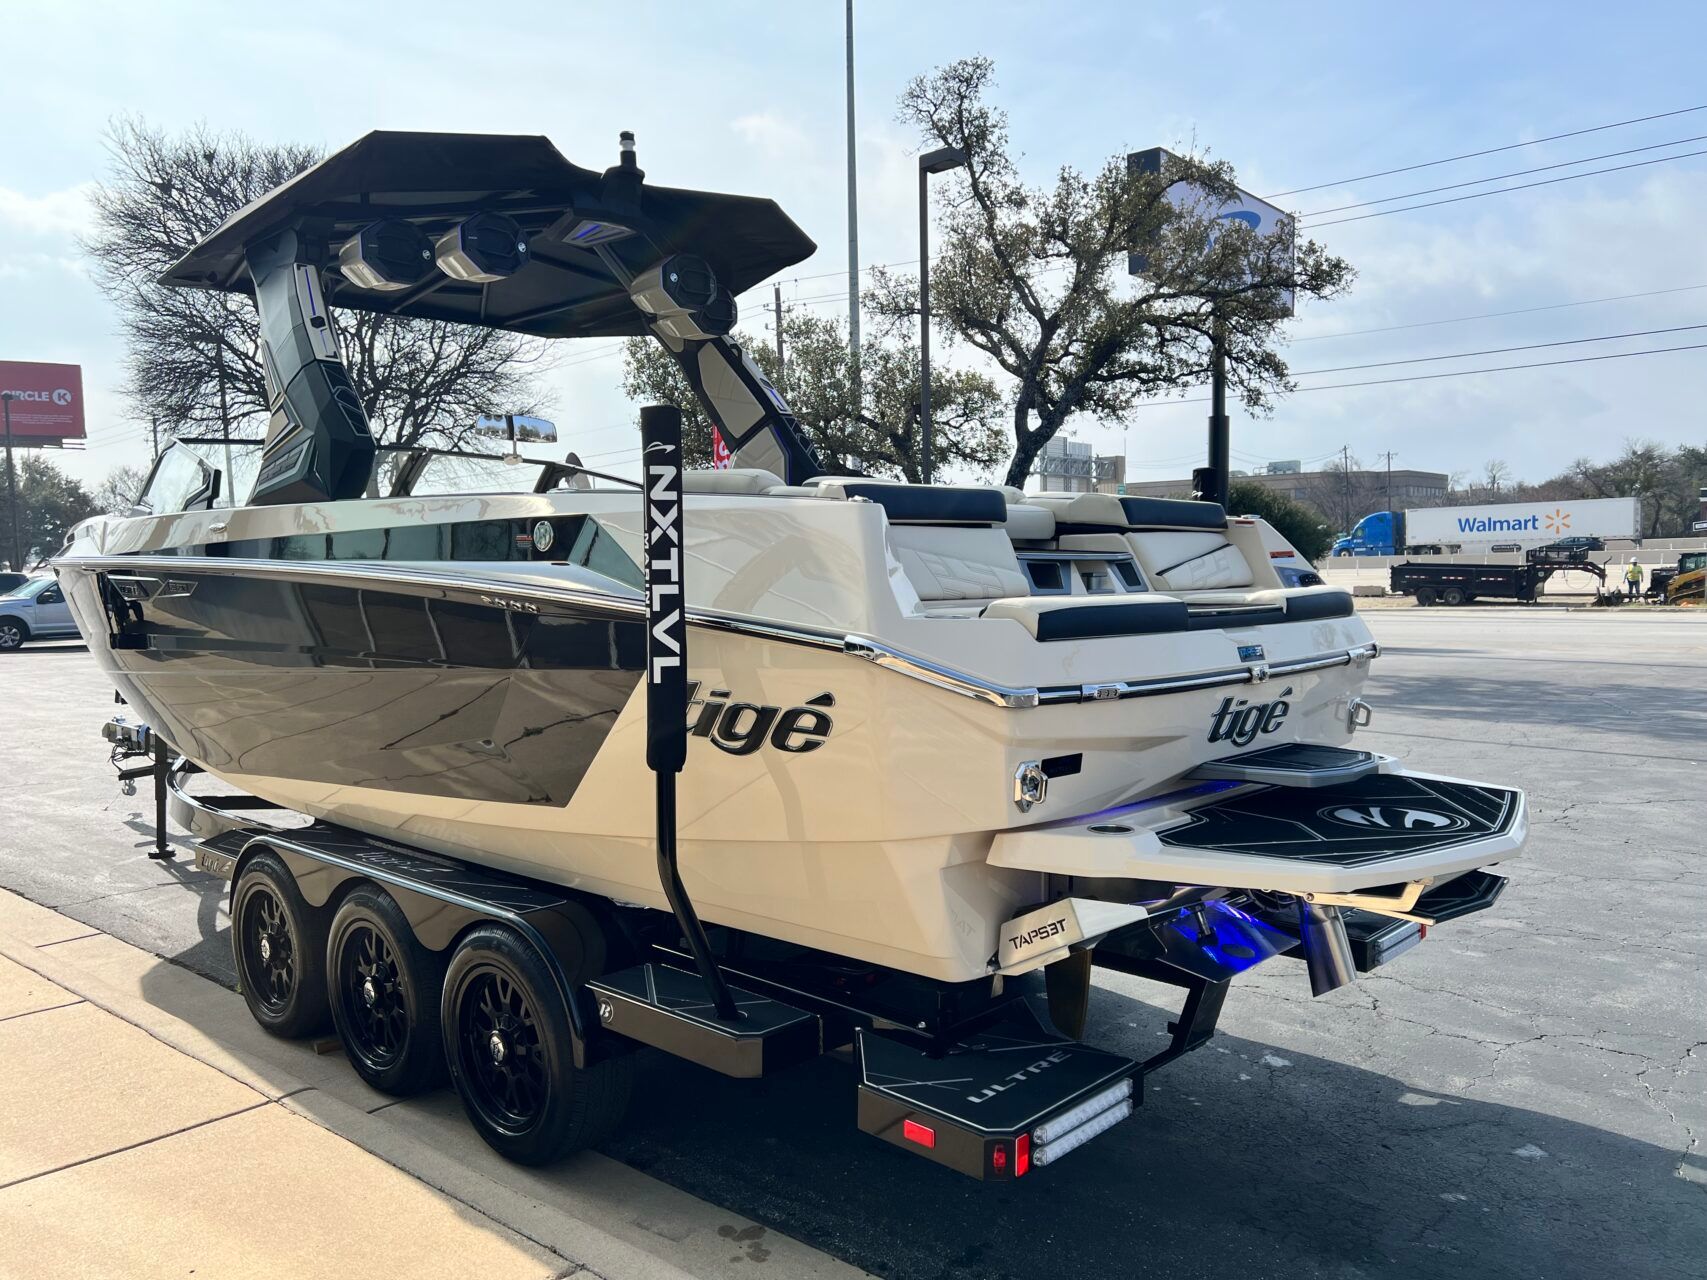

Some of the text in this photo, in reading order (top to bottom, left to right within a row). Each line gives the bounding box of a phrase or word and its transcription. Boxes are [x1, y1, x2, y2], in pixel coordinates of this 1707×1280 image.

[54, 390, 71, 404] K
[1457, 515, 1539, 532] Walmart
[649, 465, 681, 684] NXTLVL
[1207, 686, 1293, 747] tigé
